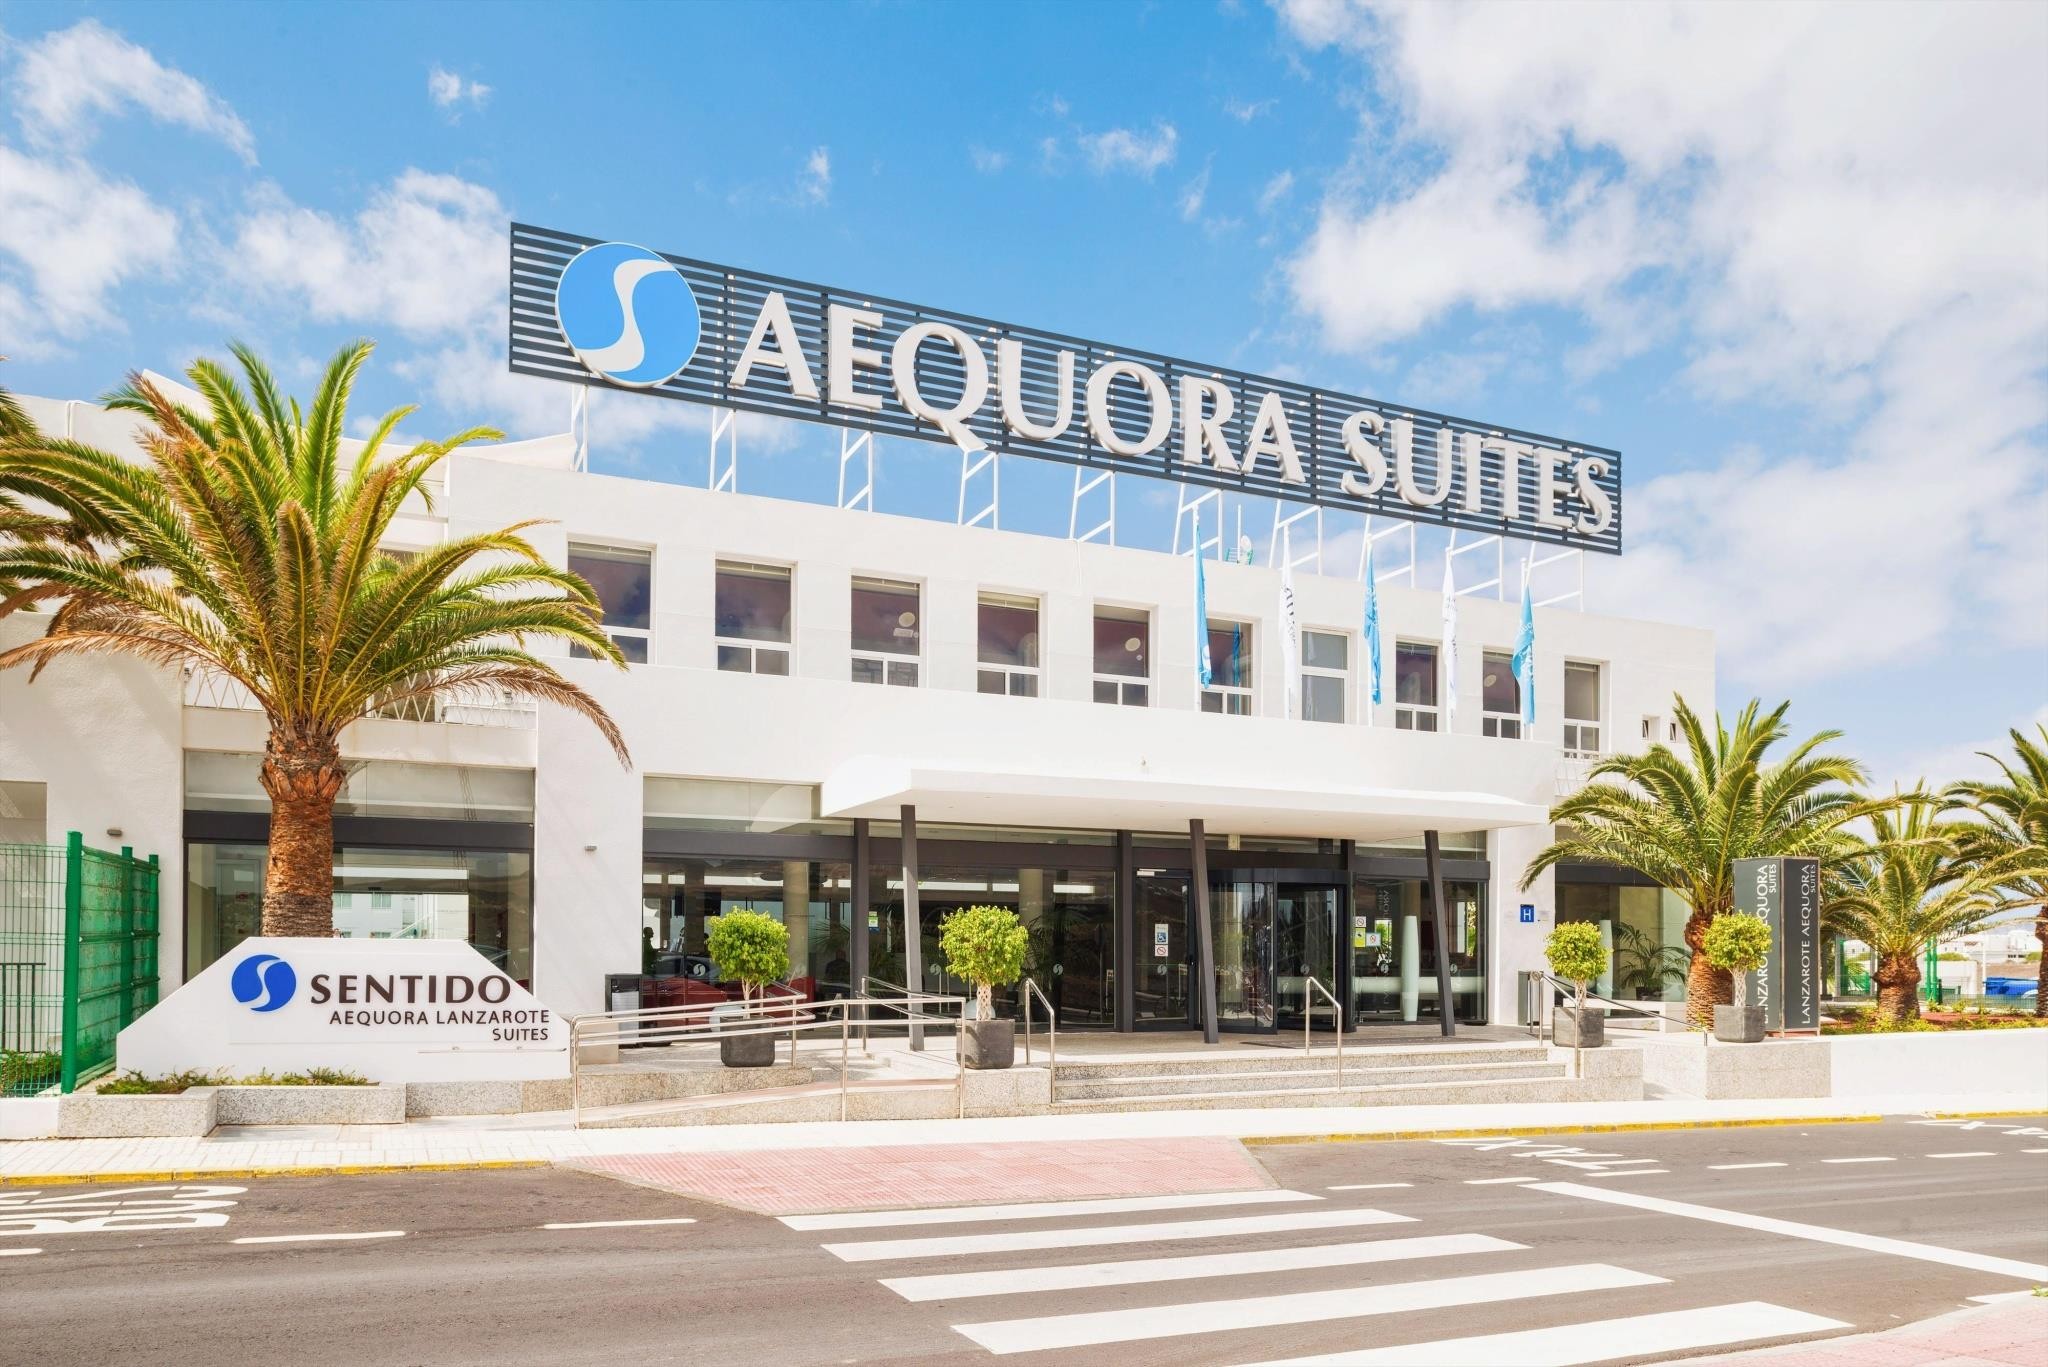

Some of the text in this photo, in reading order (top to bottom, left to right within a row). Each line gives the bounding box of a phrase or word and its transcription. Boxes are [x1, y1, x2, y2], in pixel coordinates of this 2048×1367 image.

[728, 291, 1612, 534] AEQUORA SUITES
[1768, 863, 1777, 894] SUITES
[1756, 864, 1770, 927] QUORA
[1523, 908, 1532, 921] H
[1801, 864, 1812, 1024] LANZAROTE AEQUORA
[310, 974, 511, 1004] SENTIDO
[329, 1010, 549, 1026] AEQUORA LANZAROTE
[493, 1028, 549, 1041] SUITES
